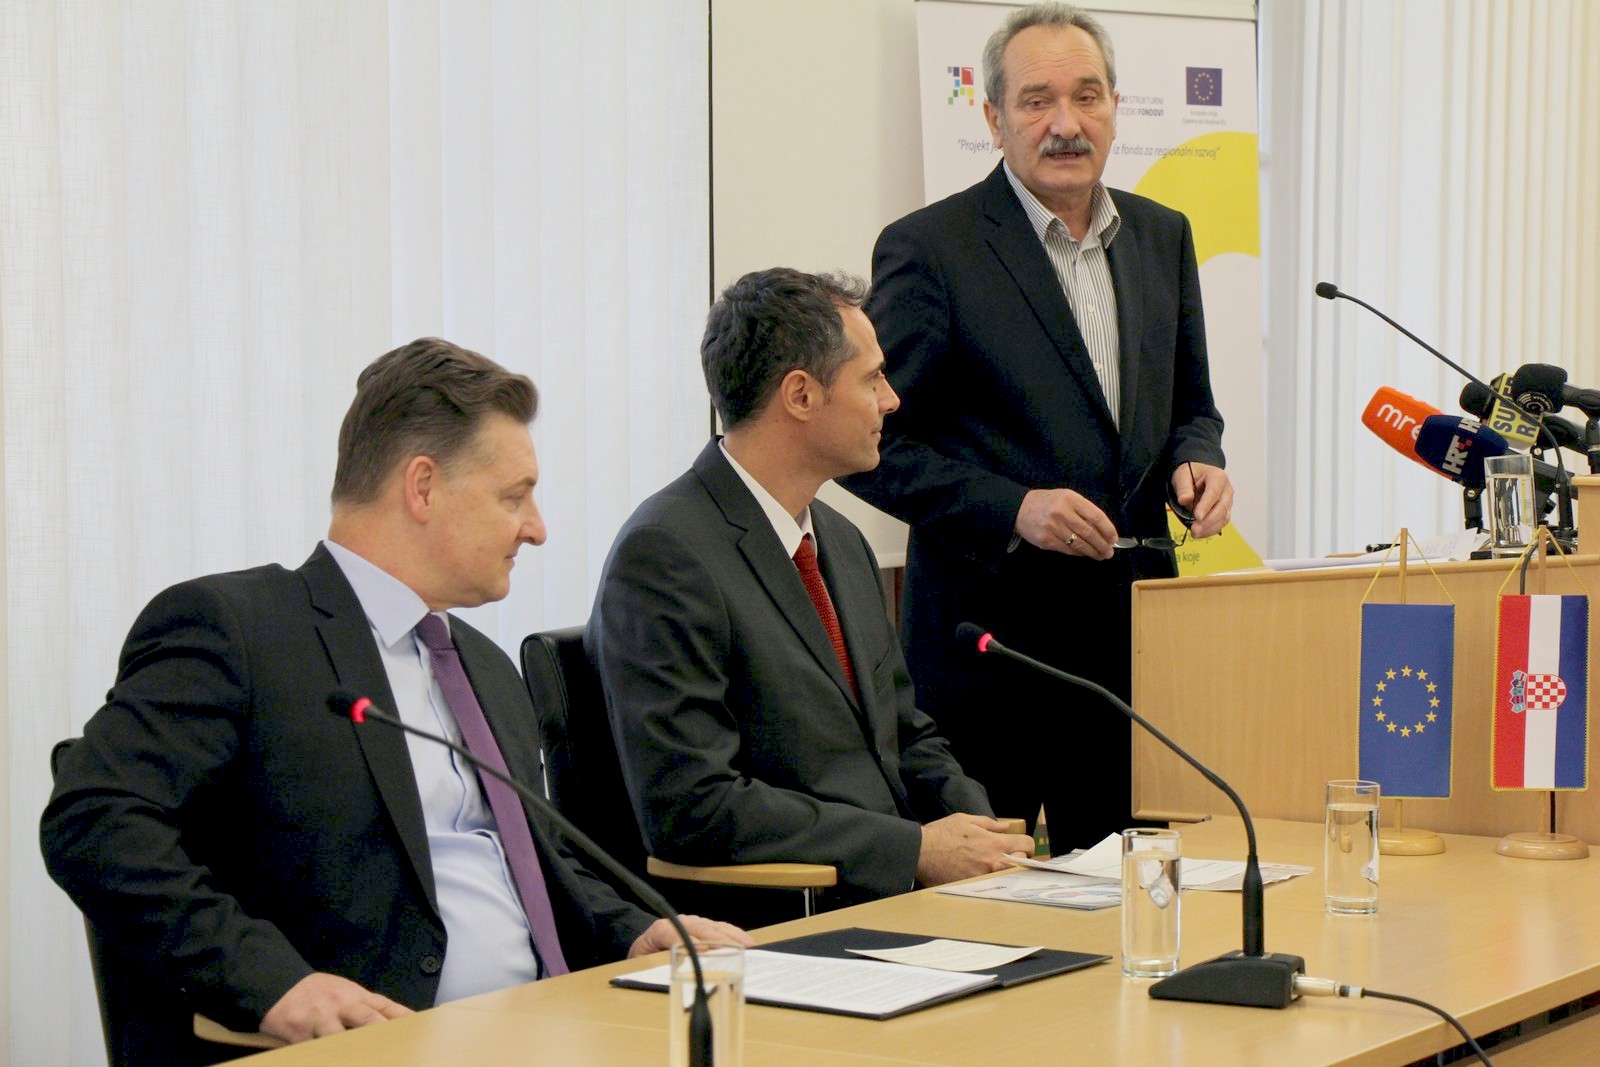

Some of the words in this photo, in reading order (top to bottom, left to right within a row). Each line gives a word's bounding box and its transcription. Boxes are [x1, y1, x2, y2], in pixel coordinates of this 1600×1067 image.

[1138, 108, 1164, 116] FONDOVI
[1113, 145, 1120, 155] iz
[1122, 144, 1143, 156] fonda
[1145, 147, 1153, 156] za
[1155, 146, 1194, 159] regionalni
[1183, 551, 1200, 565] koje
